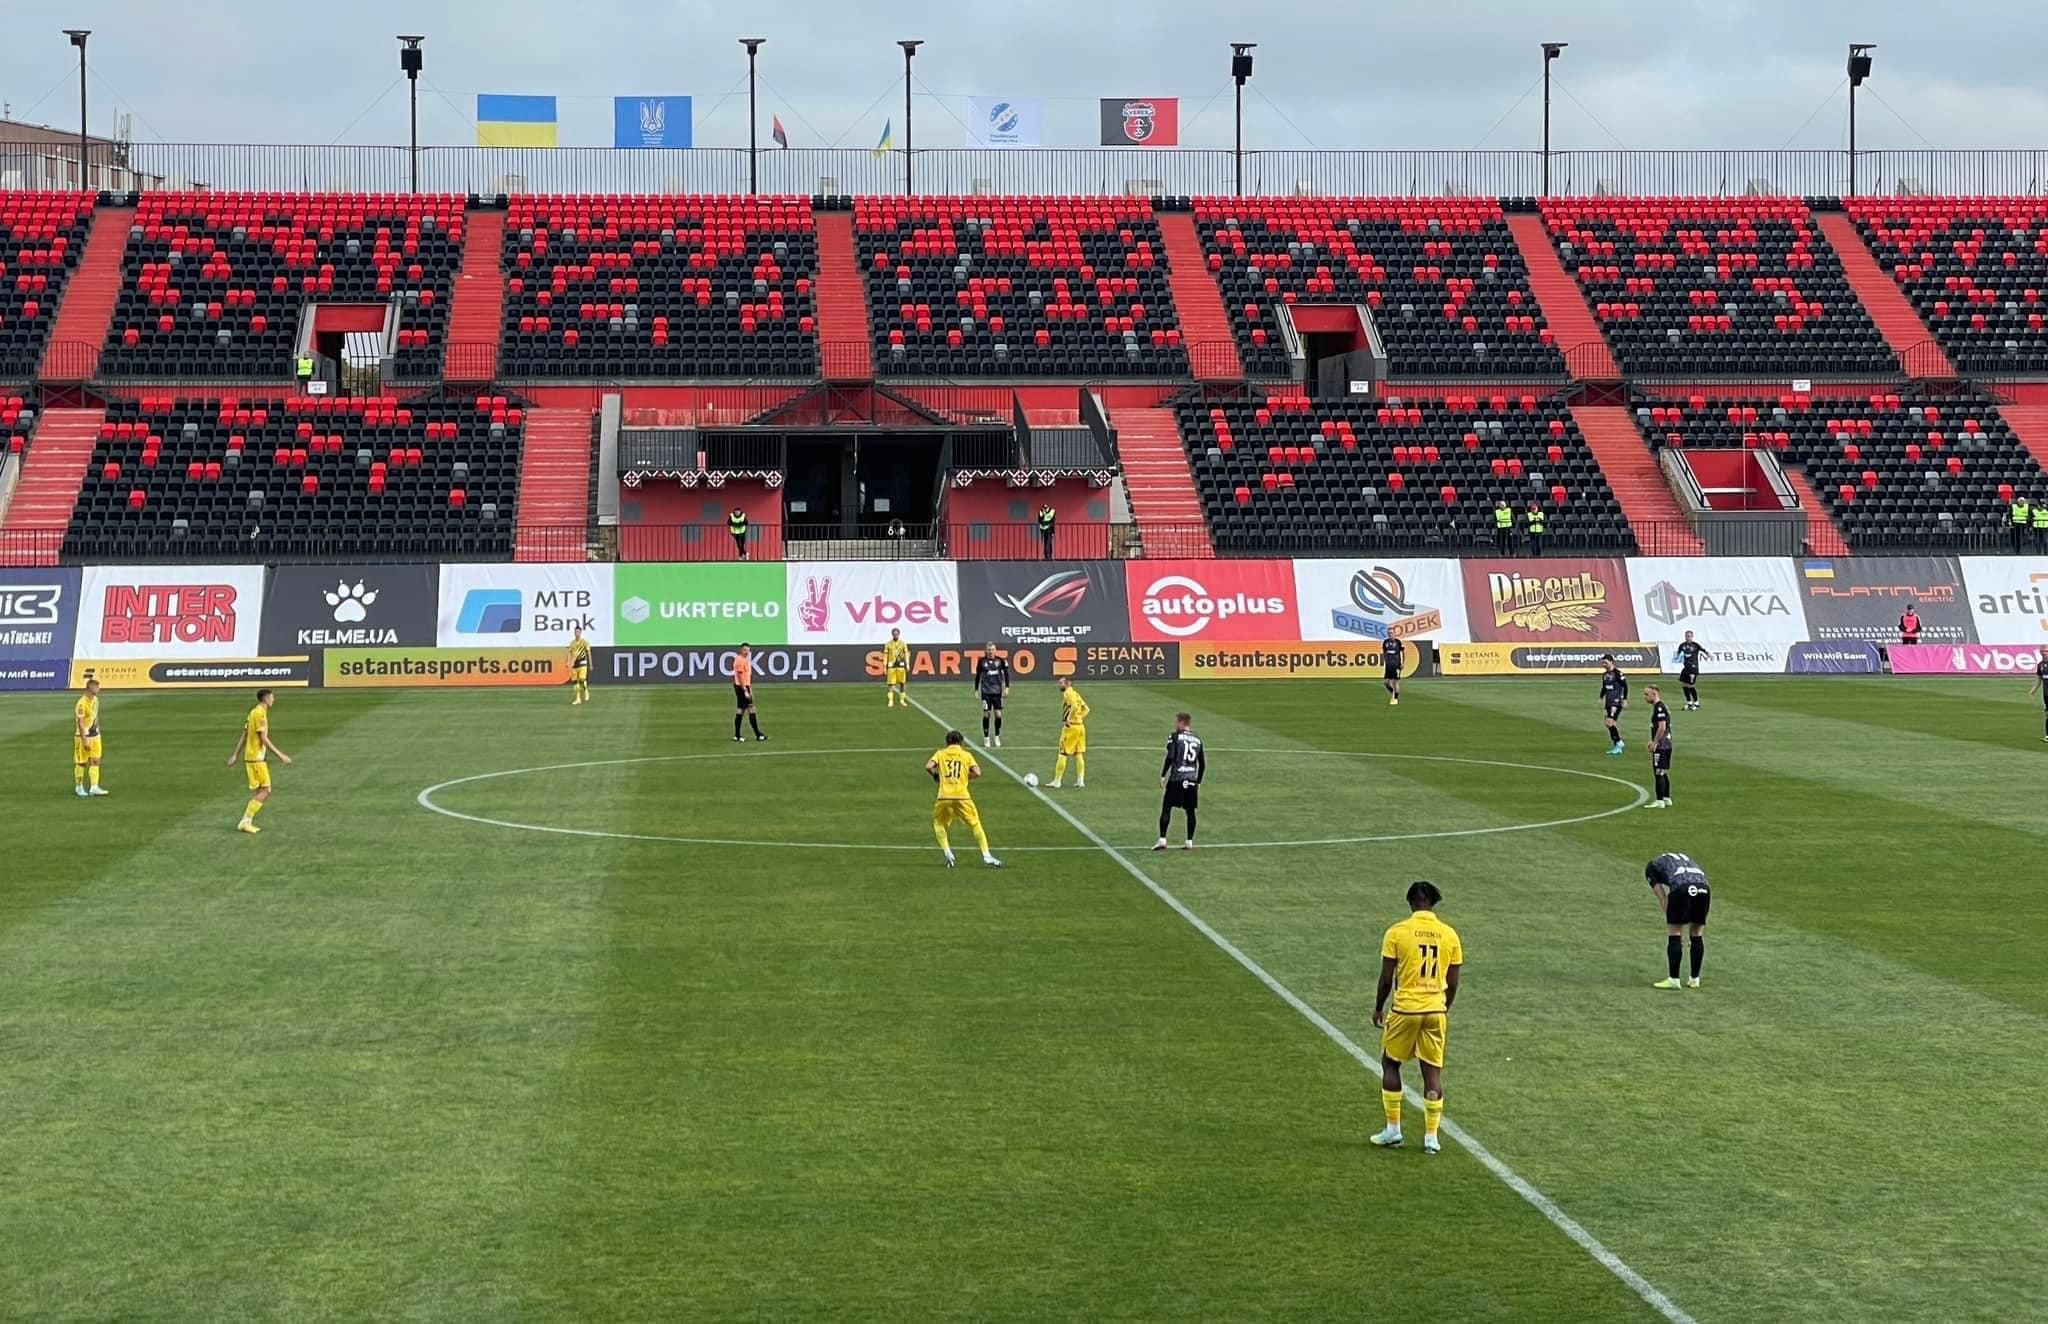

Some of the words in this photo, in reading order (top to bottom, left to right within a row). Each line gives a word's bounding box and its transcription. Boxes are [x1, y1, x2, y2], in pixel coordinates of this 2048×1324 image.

[104, 584, 237, 616] INTER
[534, 590, 591, 608] MTB
[660, 601, 780, 619] UKRTEPLO
[845, 594, 949, 624] vbet
[100, 614, 236, 643] BETON
[534, 613, 595, 632] Bank
[1001, 625, 1070, 637] REPUBLIC
[1072, 625, 1093, 635] OF
[1335, 614, 1388, 638] ОДЕК
[1391, 613, 1439, 638] ODEK
[297, 628, 399, 645] KELME.UA
[1087, 646, 1166, 661] SETANTA
[1735, 651, 1775, 662] Bank
[1803, 652, 1823, 661] WIN
[1843, 652, 1868, 661] Банк
[165, 666, 292, 678] setantasports.com
[340, 656, 553, 679] setantasports.com
[613, 650, 829, 681] ПРОМОКОД:
[1087, 663, 1166, 676] SPORTS
[1183, 740, 1198, 762] 15
[944, 759, 962, 779] 30
